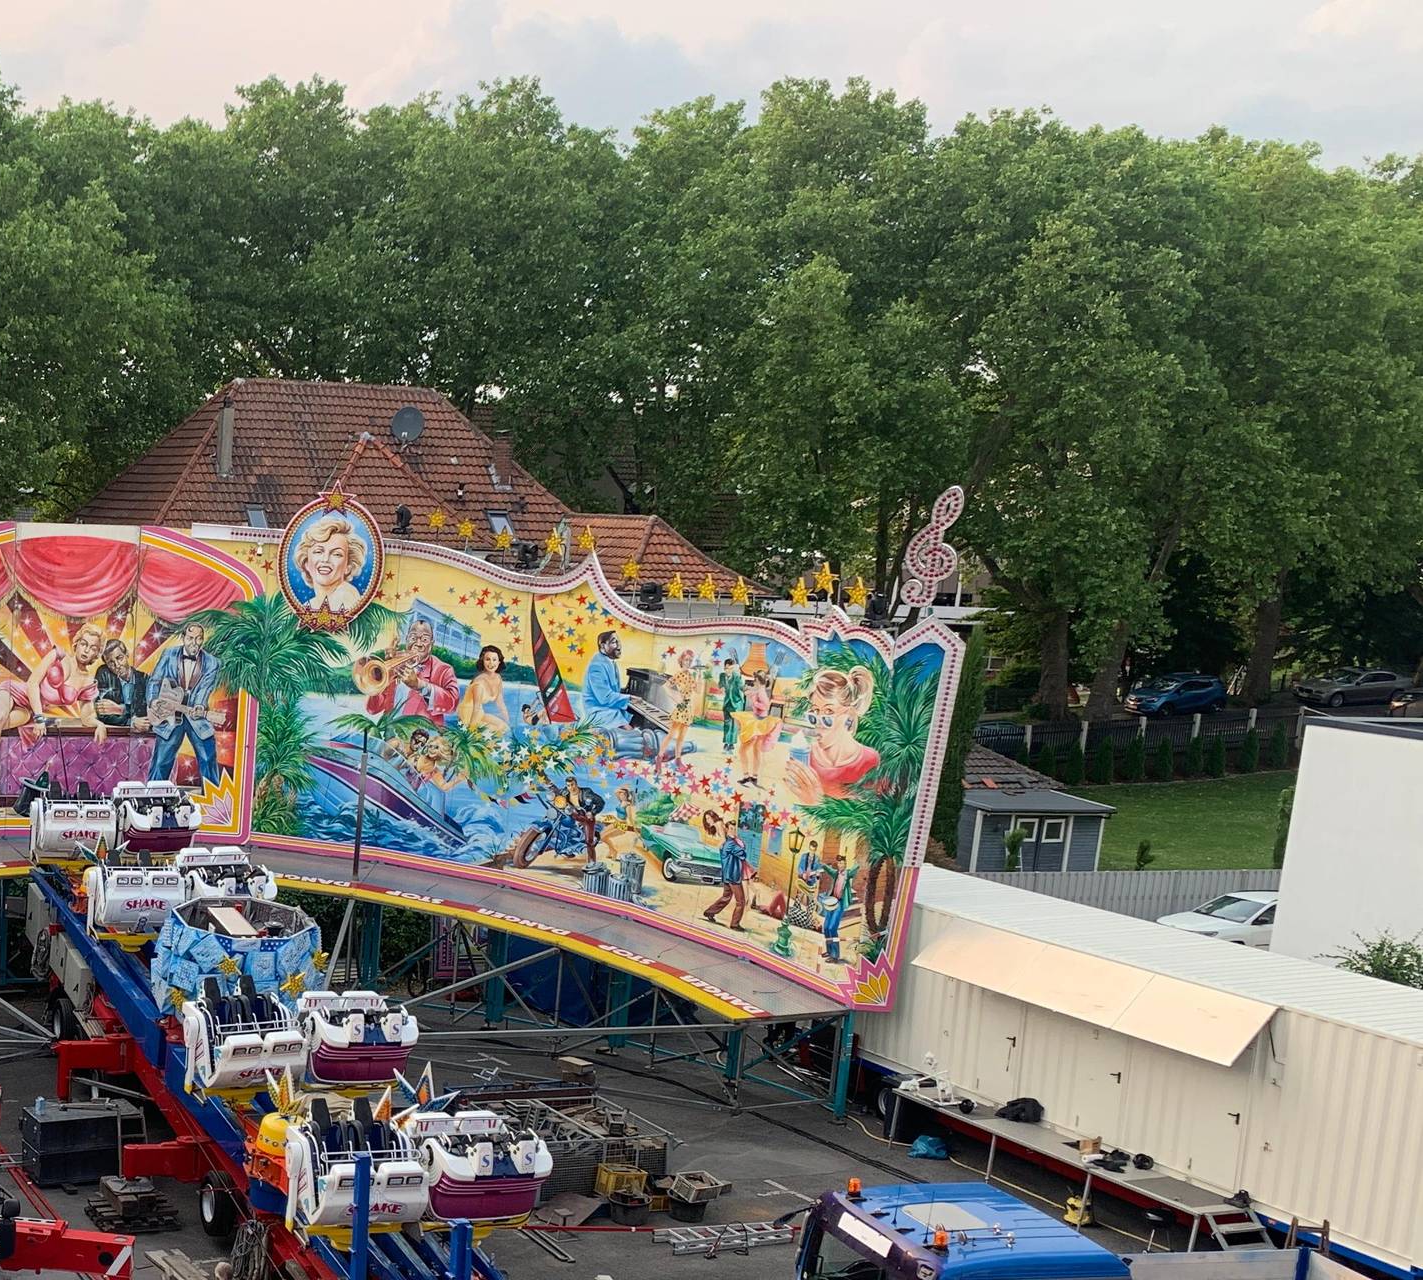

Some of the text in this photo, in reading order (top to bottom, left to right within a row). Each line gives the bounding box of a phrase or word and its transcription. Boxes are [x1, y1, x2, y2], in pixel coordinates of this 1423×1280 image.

[62, 829, 100, 840] SHAKE
[273, 872, 352, 888] DANGE
[385, 890, 445, 904] STOP
[125, 899, 167, 911] SHAKE
[477, 907, 572, 936] DANGER
[598, 944, 657, 965] STOP
[679, 975, 765, 1014] DANGER
[353, 1023, 361, 1036] S
[391, 1023, 400, 1035] S
[481, 1154, 490, 1168] S
[524, 1151, 533, 1166] S
[345, 1202, 403, 1216] SAKE
